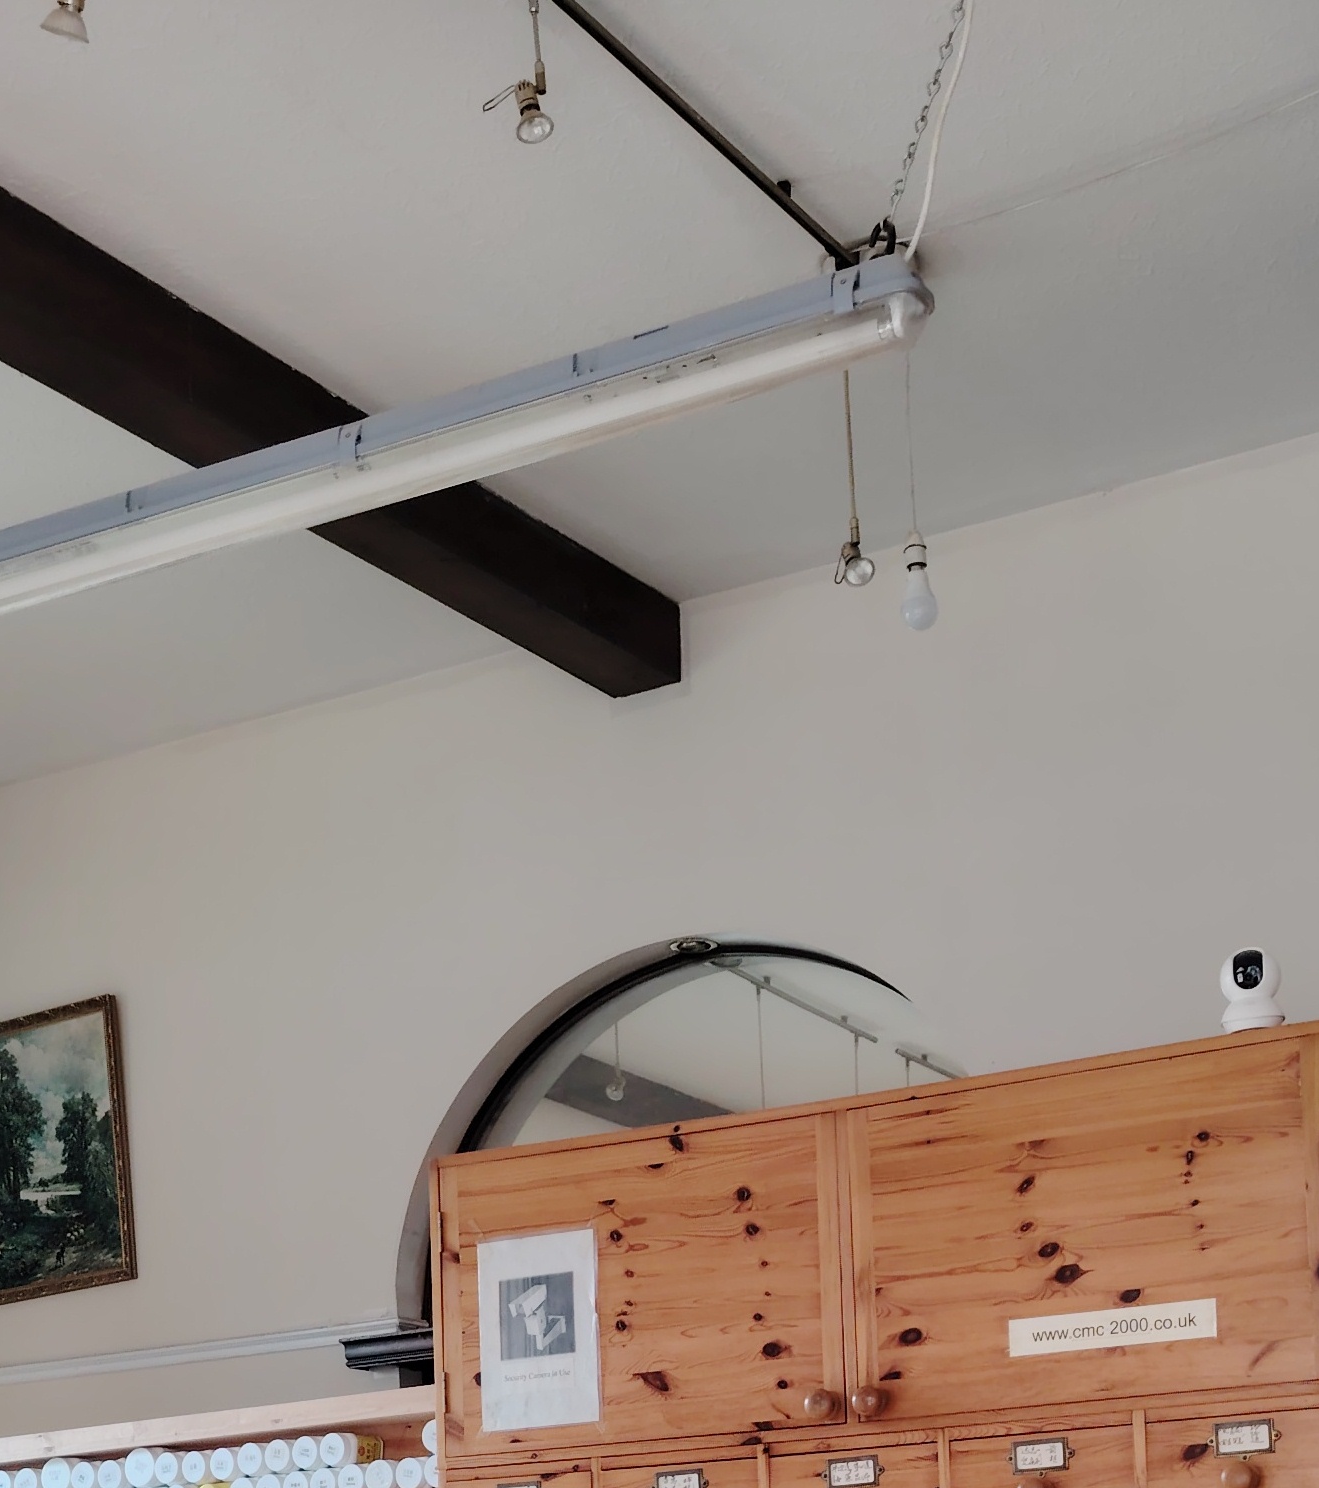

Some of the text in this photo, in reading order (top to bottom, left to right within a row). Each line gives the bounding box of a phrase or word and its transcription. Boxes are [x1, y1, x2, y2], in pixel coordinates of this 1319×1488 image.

[1032, 1312, 1198, 1343] www.cmc 2000.co.uk
[503, 1372, 527, 1383] Security
[529, 1370, 552, 1381] Camera
[558, 1368, 571, 1377] Use
